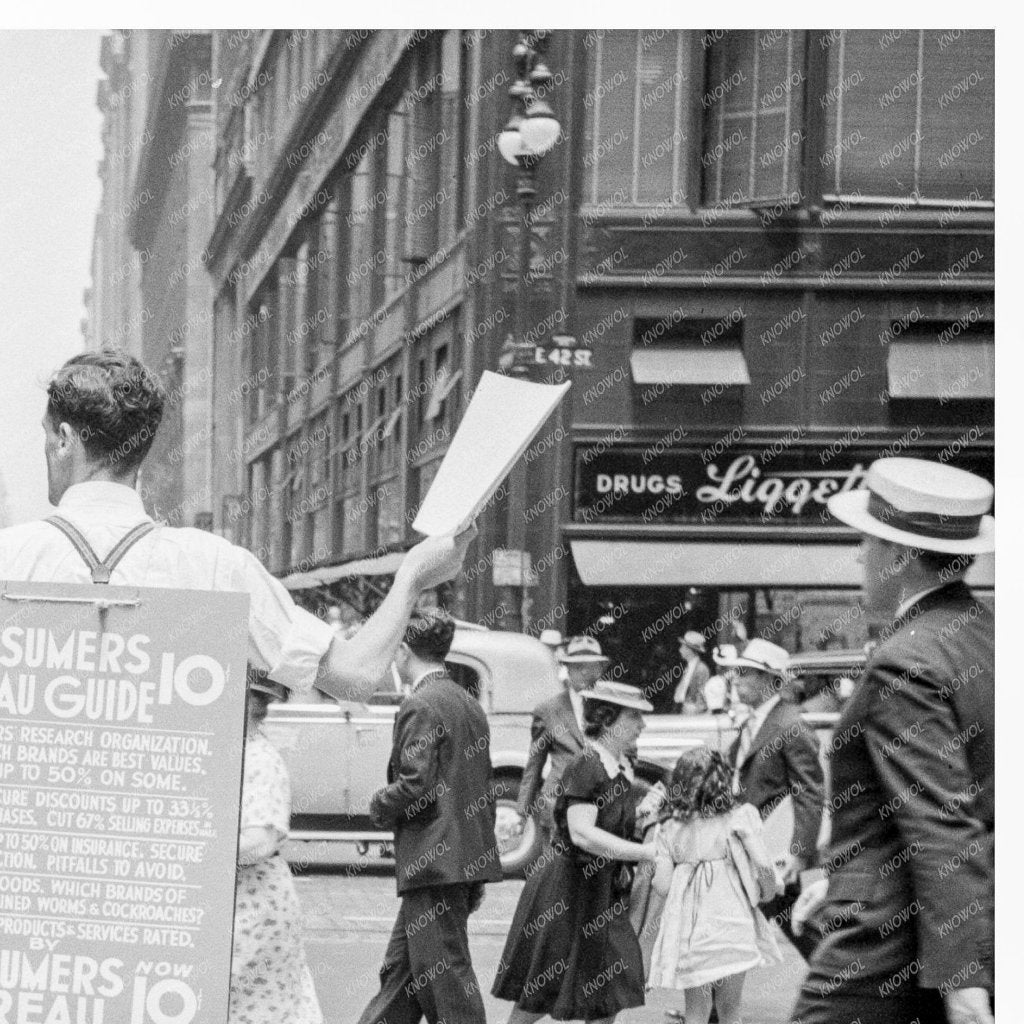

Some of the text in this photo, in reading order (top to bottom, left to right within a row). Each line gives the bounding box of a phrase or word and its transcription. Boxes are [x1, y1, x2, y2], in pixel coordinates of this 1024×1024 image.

[596, 455, 869, 514] DRUGS Ligget
[44, 675, 157, 723] GUIDE
[20, 726, 94, 747] RESEARCH
[100, 731, 213, 756] ORGANIZATION.
[16, 744, 78, 765] BRANDS
[82, 750, 108, 767] ARE
[111, 752, 145, 770] BEST
[151, 754, 207, 776] VALUES.
[20, 763, 40, 780] TO
[47, 765, 92, 785] 50%
[100, 769, 125, 787] ON
[130, 771, 187, 792] SOME.
[36, 790, 116, 812] DISCOUNTS
[122, 798, 141, 814] UP
[146, 798, 164, 816] TO
[46, 810, 74, 828] CUT
[76, 812, 105, 831] 67%
[108, 815, 151, 834] SELLING
[6, 832, 19, 849] TO
[21, 834, 49, 852] 50%
[50, 836, 68, 854] ON
[150, 843, 204, 863] SECURE
[47, 855, 109, 875] PITFALLS
[113, 859, 131, 877] TO
[134, 861, 186, 882] AVOID.
[51, 879, 101, 898] WHICH
[105, 883, 163, 903] BRANDS
[165, 888, 187, 904] OF
[37, 896, 85, 915] WORMS
[89, 903, 100, 915] &
[102, 901, 204, 925] COCKROACHES?
[29, 937, 61, 951] BY
[143, 929, 195, 948] RATED.
[134, 960, 194, 977] NOW
